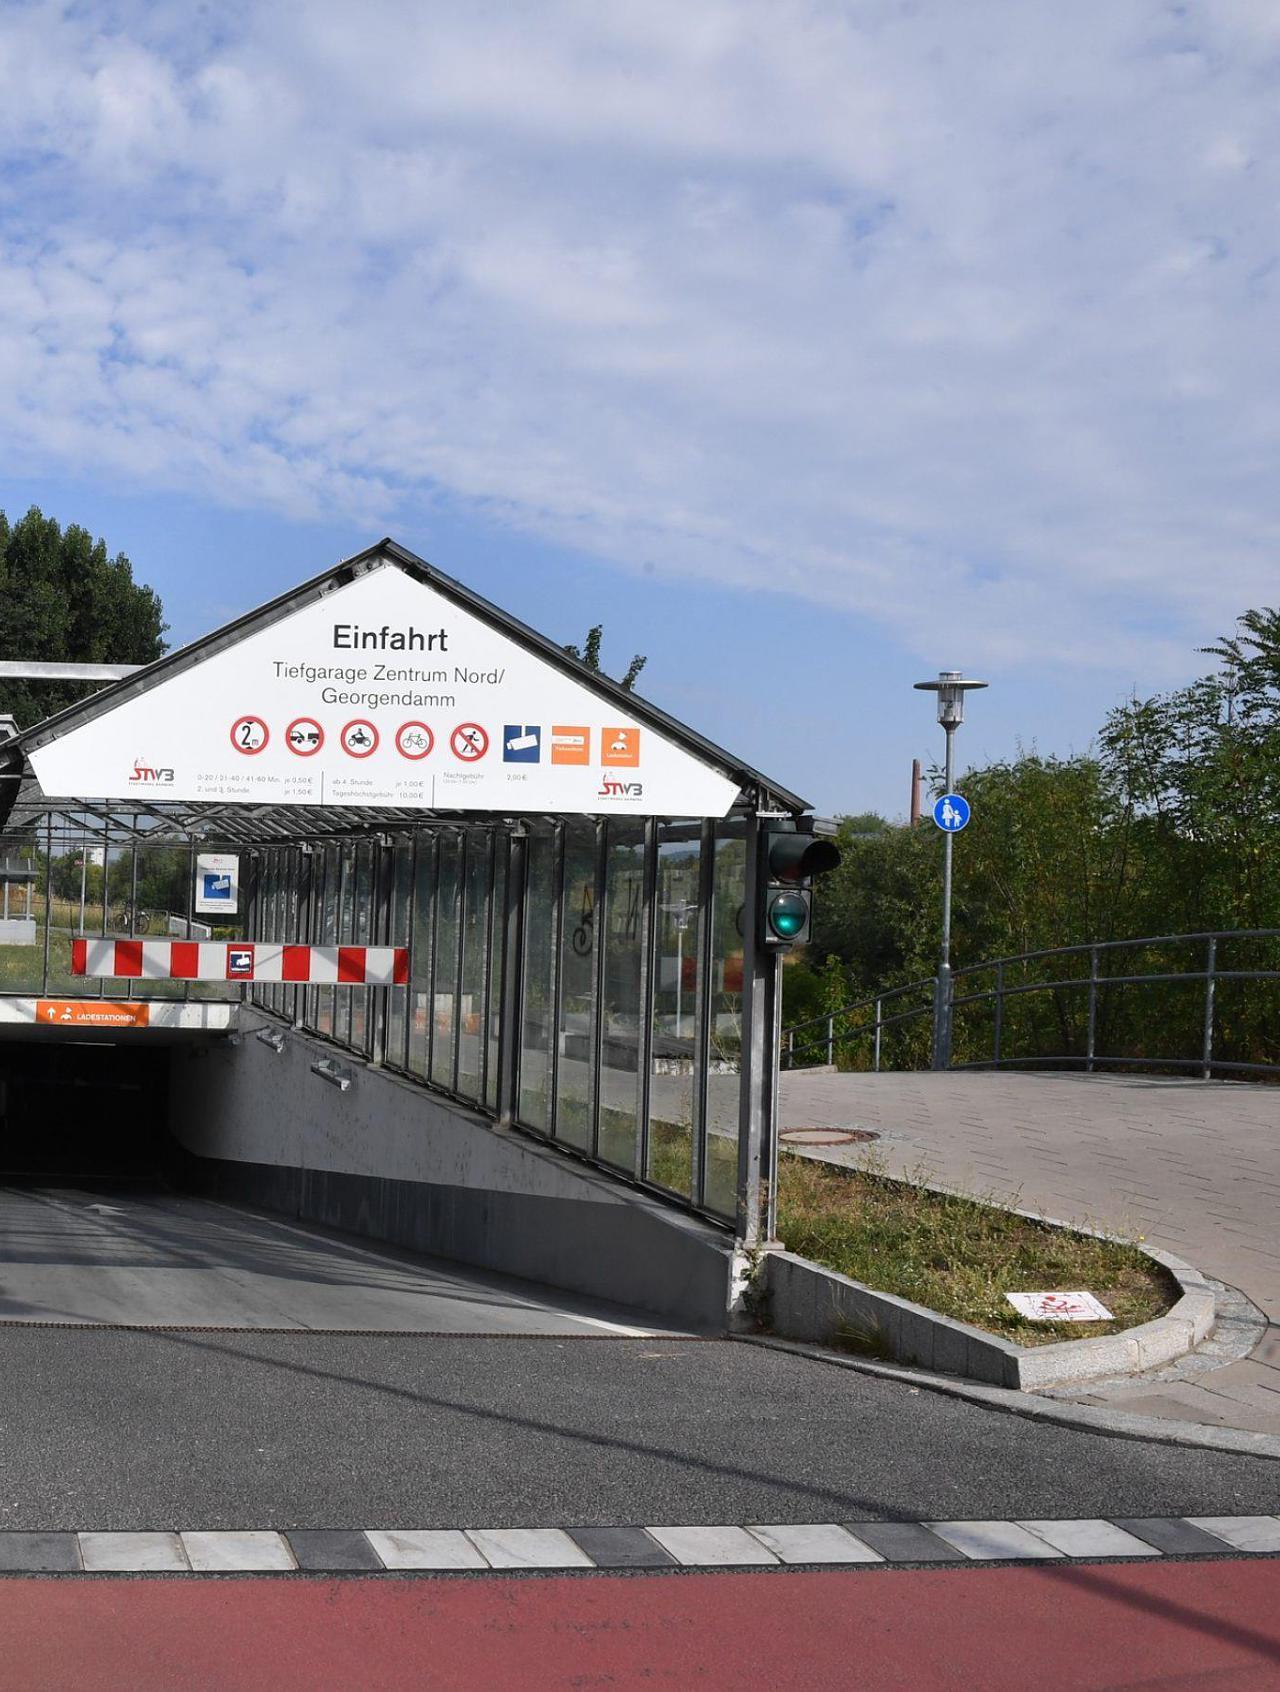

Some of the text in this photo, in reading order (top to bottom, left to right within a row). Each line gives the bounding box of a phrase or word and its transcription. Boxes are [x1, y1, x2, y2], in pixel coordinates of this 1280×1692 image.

[333, 624, 449, 652] Einfahrt
[272, 661, 506, 685] Tiefgarage Zentrum Nord/
[321, 687, 456, 710] Georgendamm
